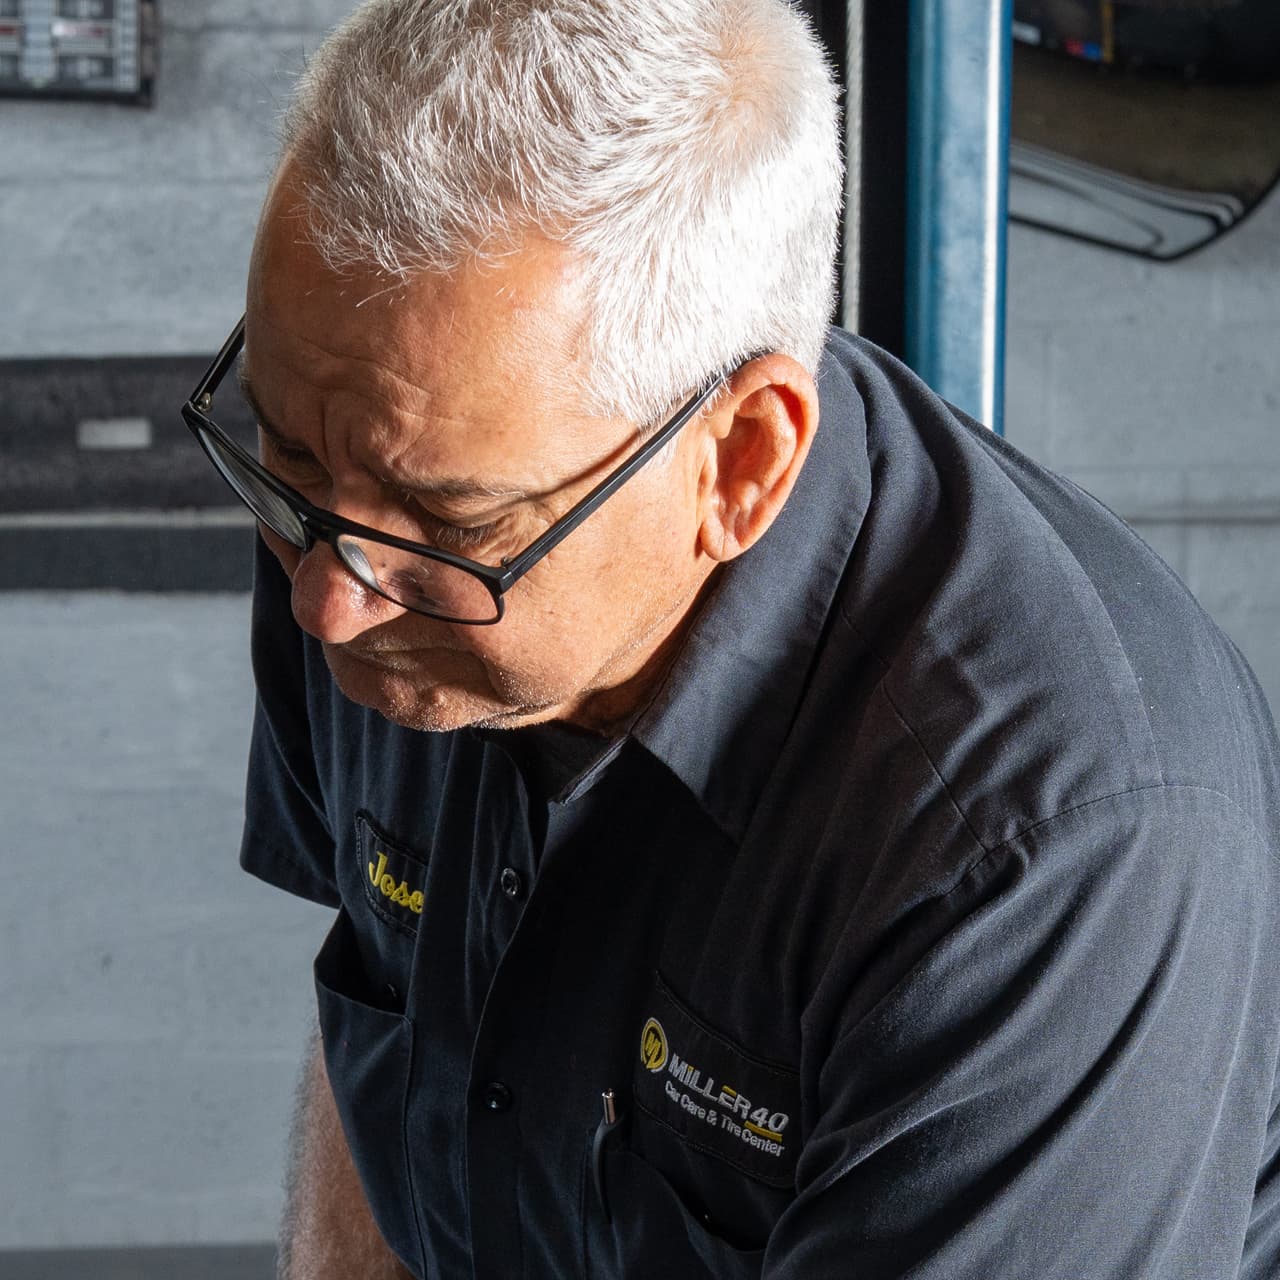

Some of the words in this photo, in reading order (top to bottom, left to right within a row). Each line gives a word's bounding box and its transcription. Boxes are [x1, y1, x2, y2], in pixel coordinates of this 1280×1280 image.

[369, 851, 424, 914] Jose
[665, 1080, 681, 1103] Car
[680, 1094, 706, 1119] Care
[706, 1110, 718, 1126] &
[721, 1114, 741, 1137] Tire
[741, 1128, 785, 1157] Center
